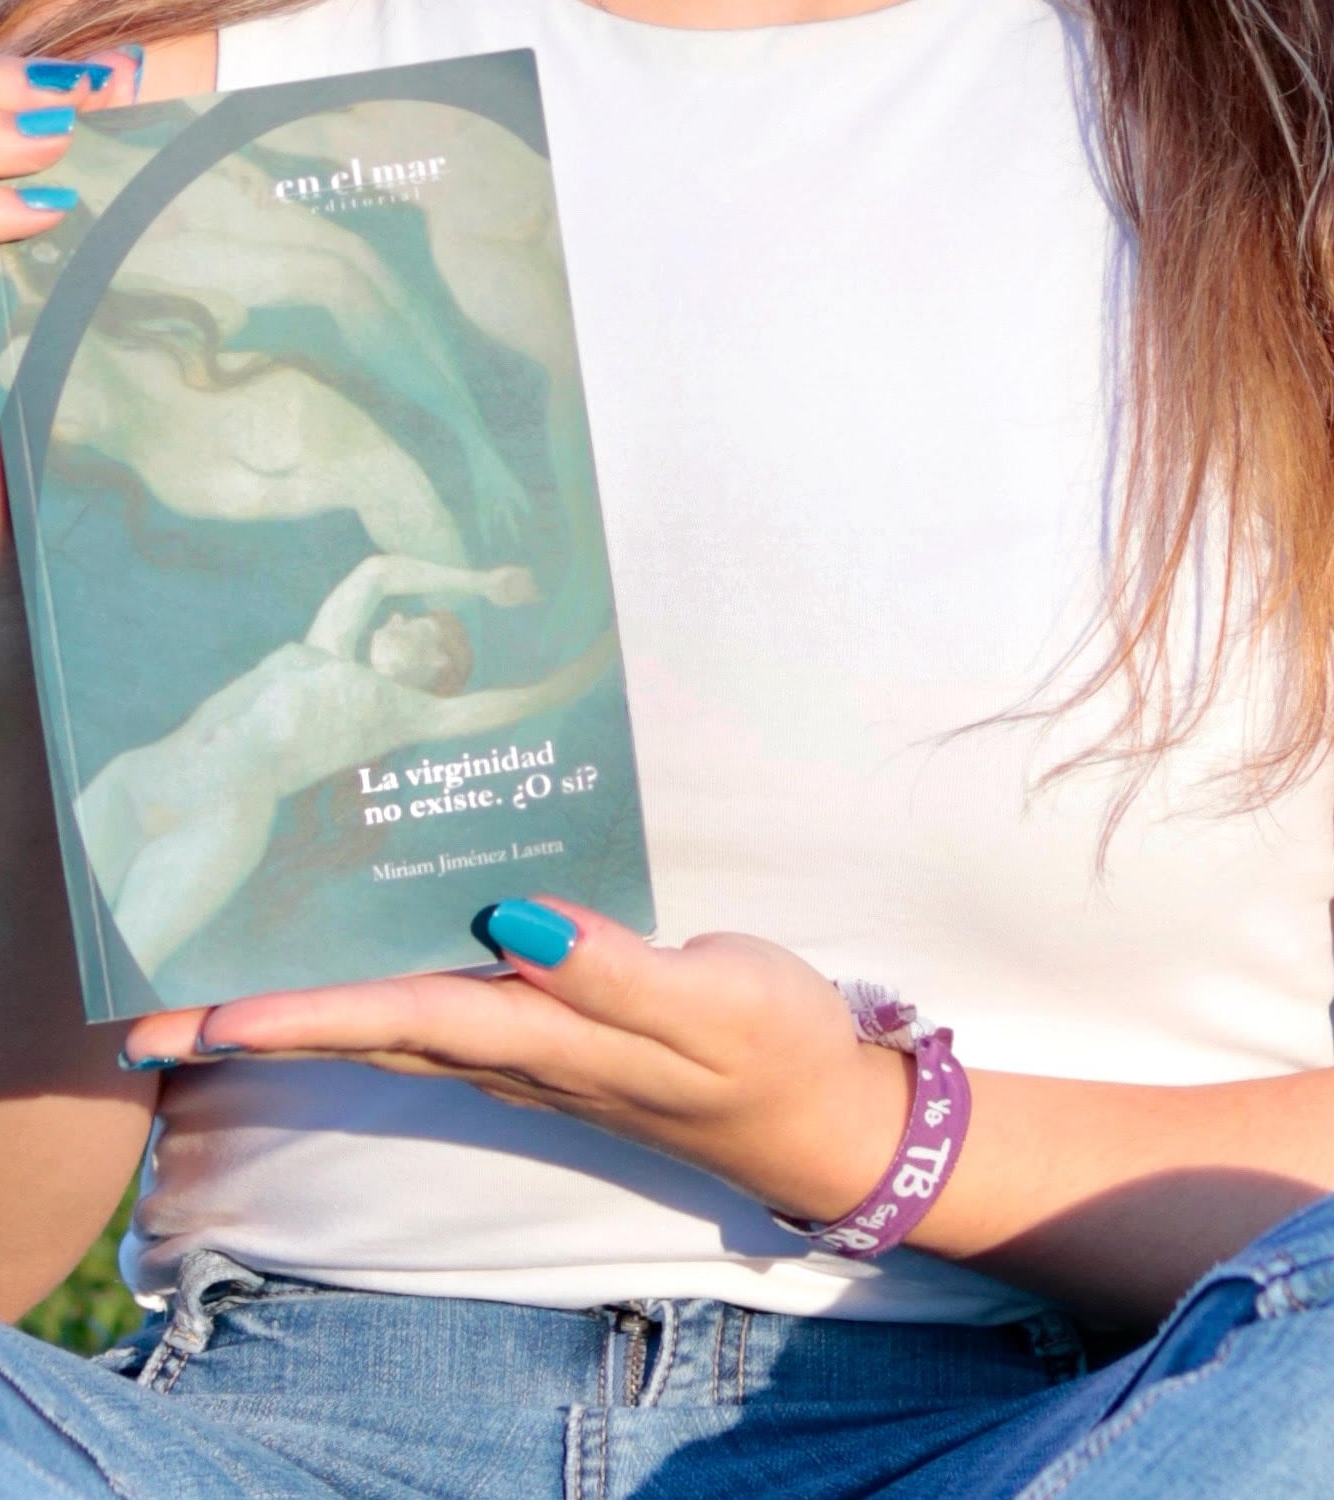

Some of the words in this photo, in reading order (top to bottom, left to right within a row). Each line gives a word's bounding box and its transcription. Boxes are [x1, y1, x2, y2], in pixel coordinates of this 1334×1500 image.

[275, 174, 320, 200] en
[331, 157, 363, 190] el
[372, 156, 447, 185] mar
[311, 187, 419, 214] editorial
[358, 767, 399, 794] La
[406, 740, 555, 789] virginidad
[364, 801, 402, 825] no
[410, 788, 503, 818] existe.
[513, 773, 552, 809] ¿O
[562, 765, 598, 795] sí?
[372, 860, 435, 882] Miriam
[438, 847, 507, 877] Jiménez
[512, 840, 565, 861] Lastra
[892, 1137, 952, 1198] TB
